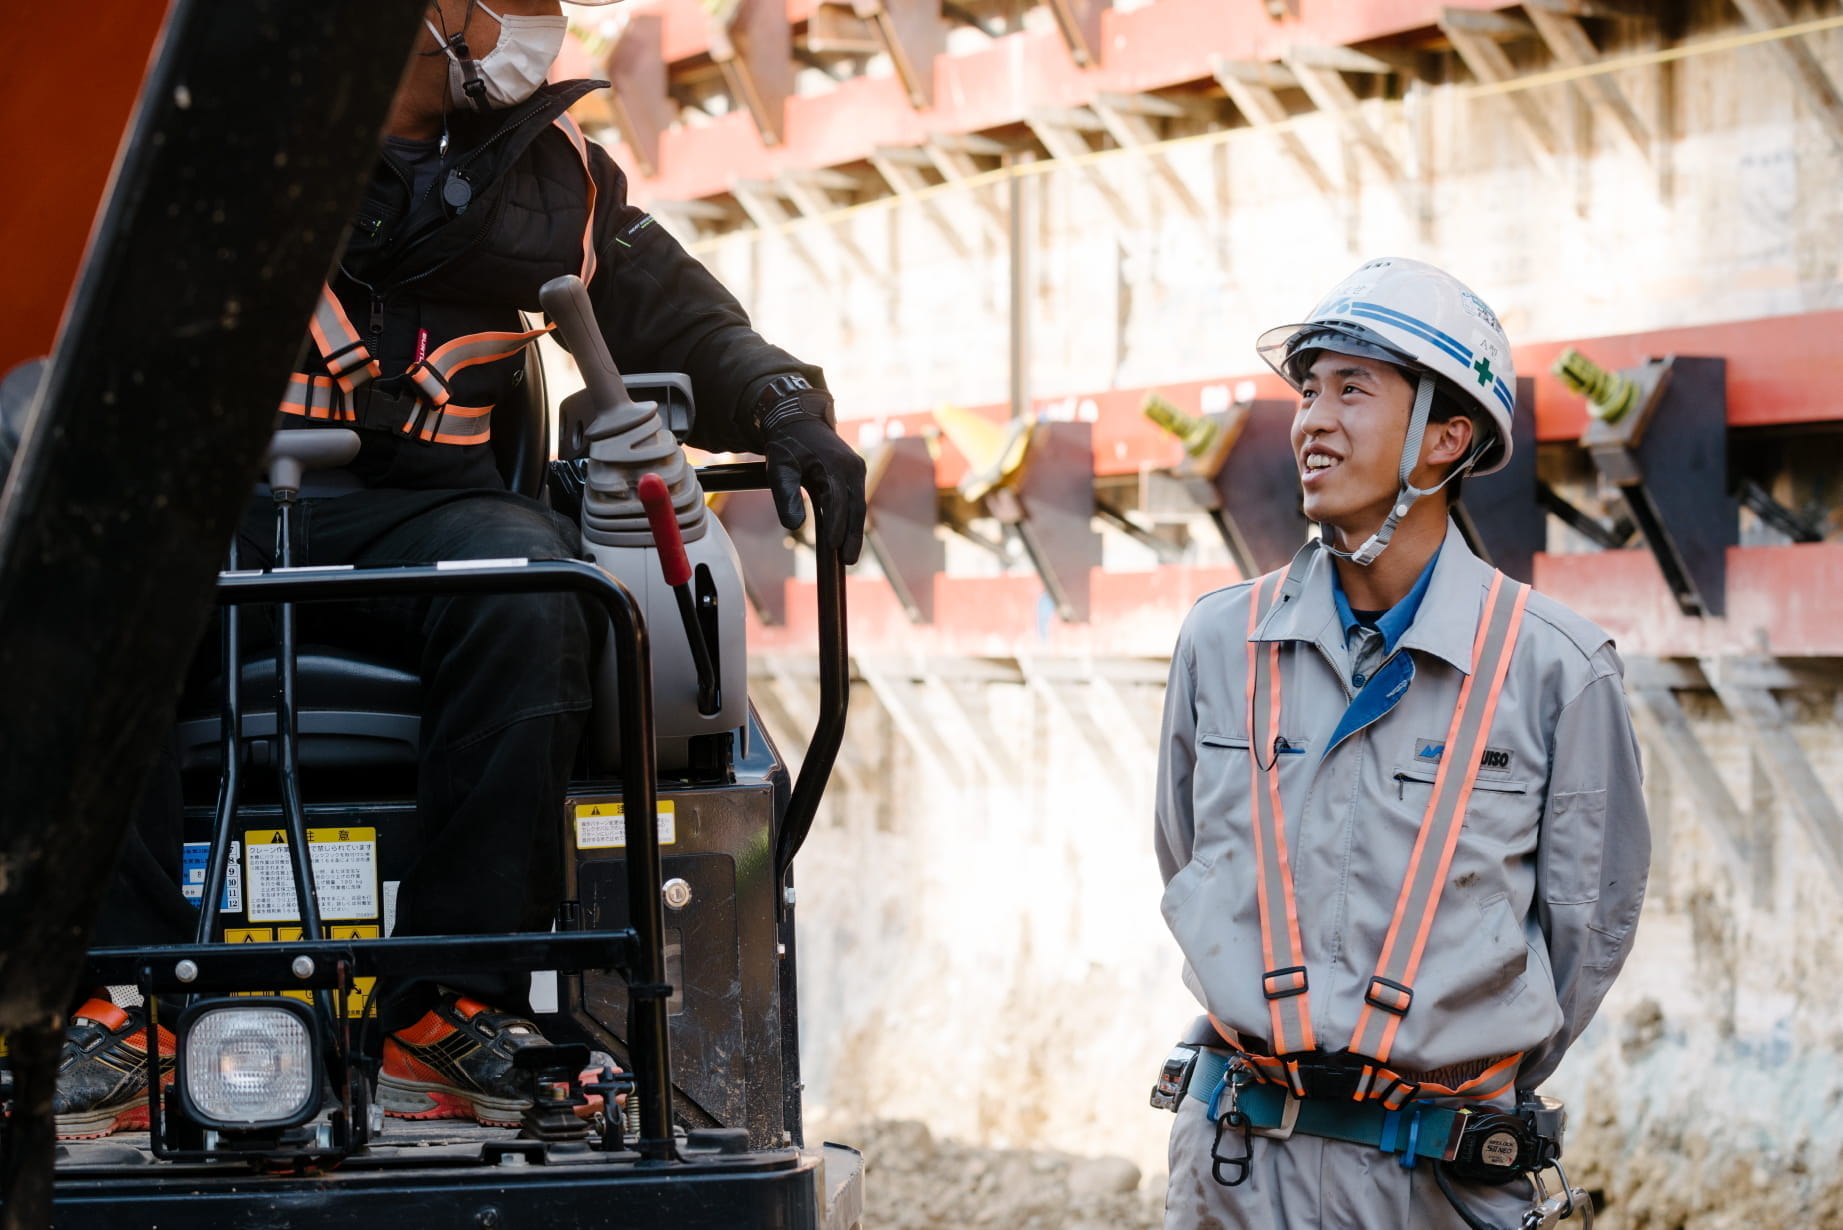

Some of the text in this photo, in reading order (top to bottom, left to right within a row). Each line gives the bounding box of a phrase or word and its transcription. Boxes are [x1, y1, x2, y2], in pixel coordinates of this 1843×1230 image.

[1481, 750, 1509, 767] UISO
[228, 867, 234, 875] 9
[228, 878, 236, 886] 10
[229, 889, 236, 897] 11
[229, 899, 237, 907] 12
